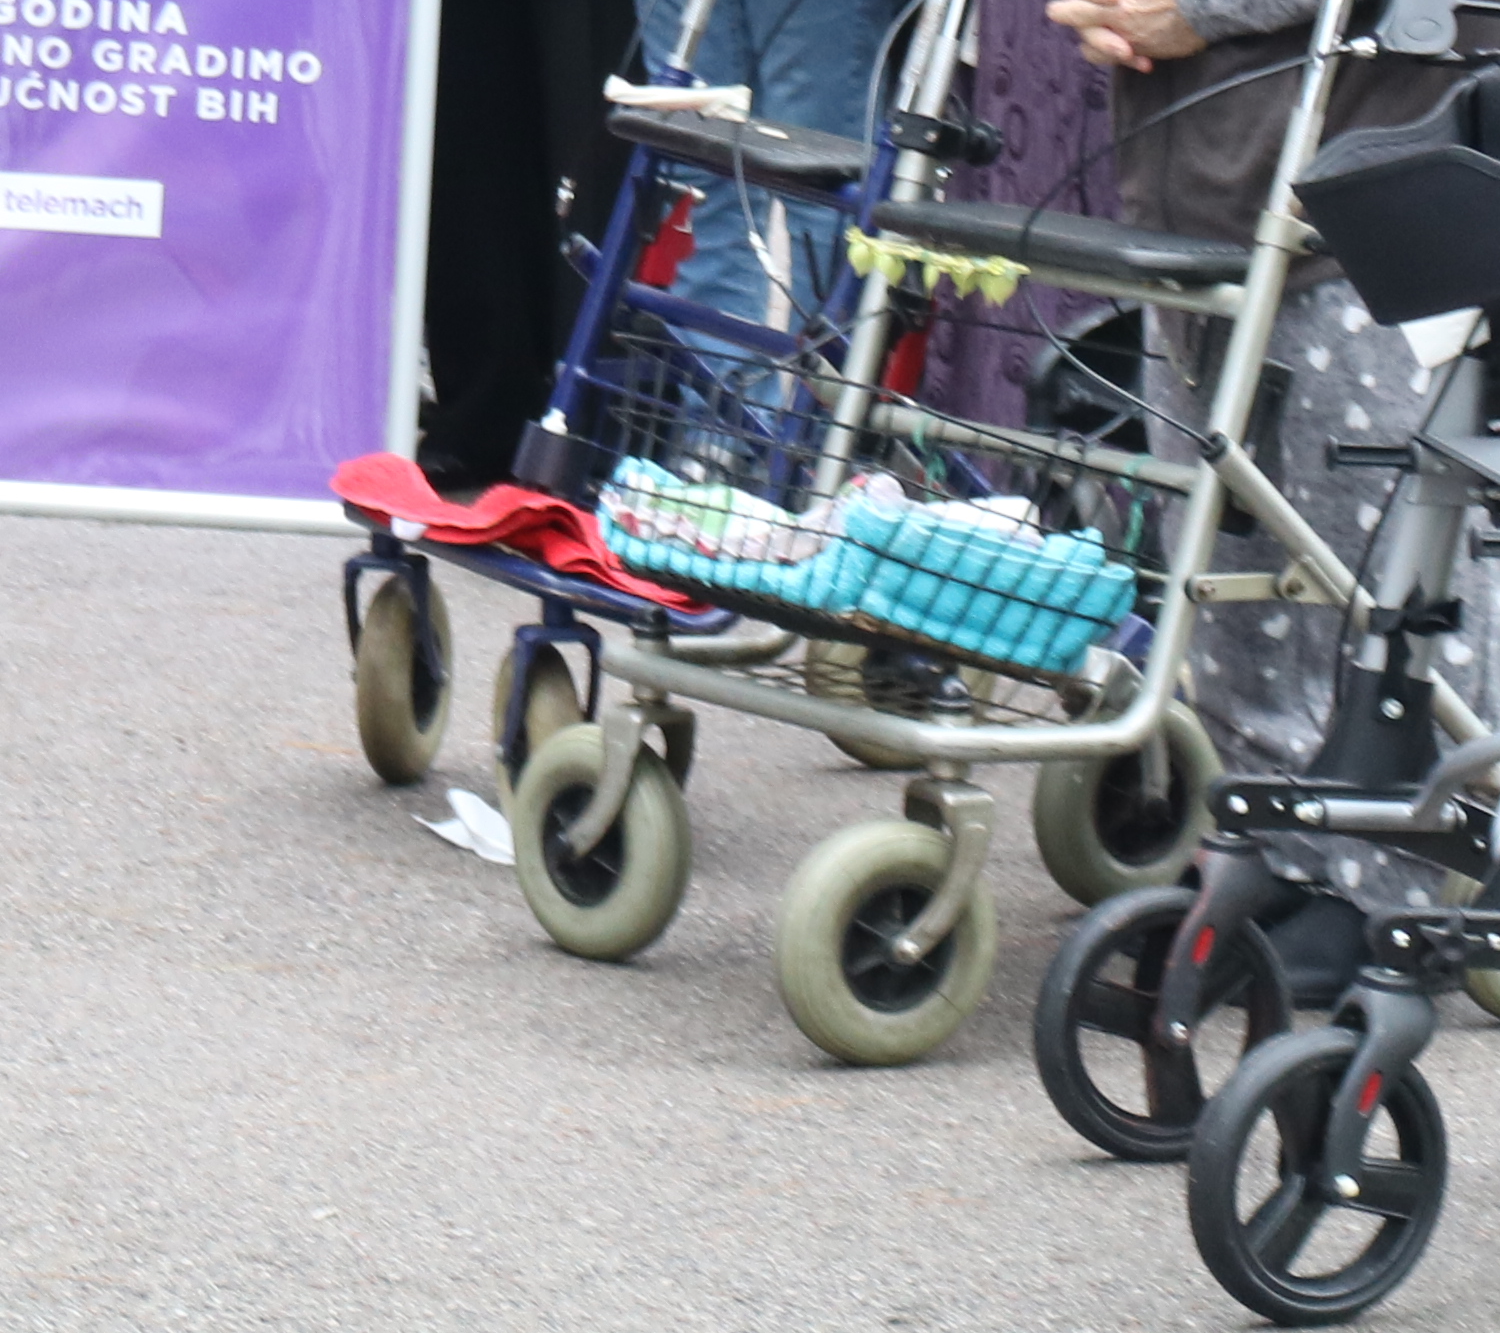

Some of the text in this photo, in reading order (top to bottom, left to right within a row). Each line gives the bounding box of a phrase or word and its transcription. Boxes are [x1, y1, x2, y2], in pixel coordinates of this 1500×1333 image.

[92, 39, 322, 85] GRADIMO
[196, 87, 279, 124] BIH
[4, 188, 144, 221] telemach
